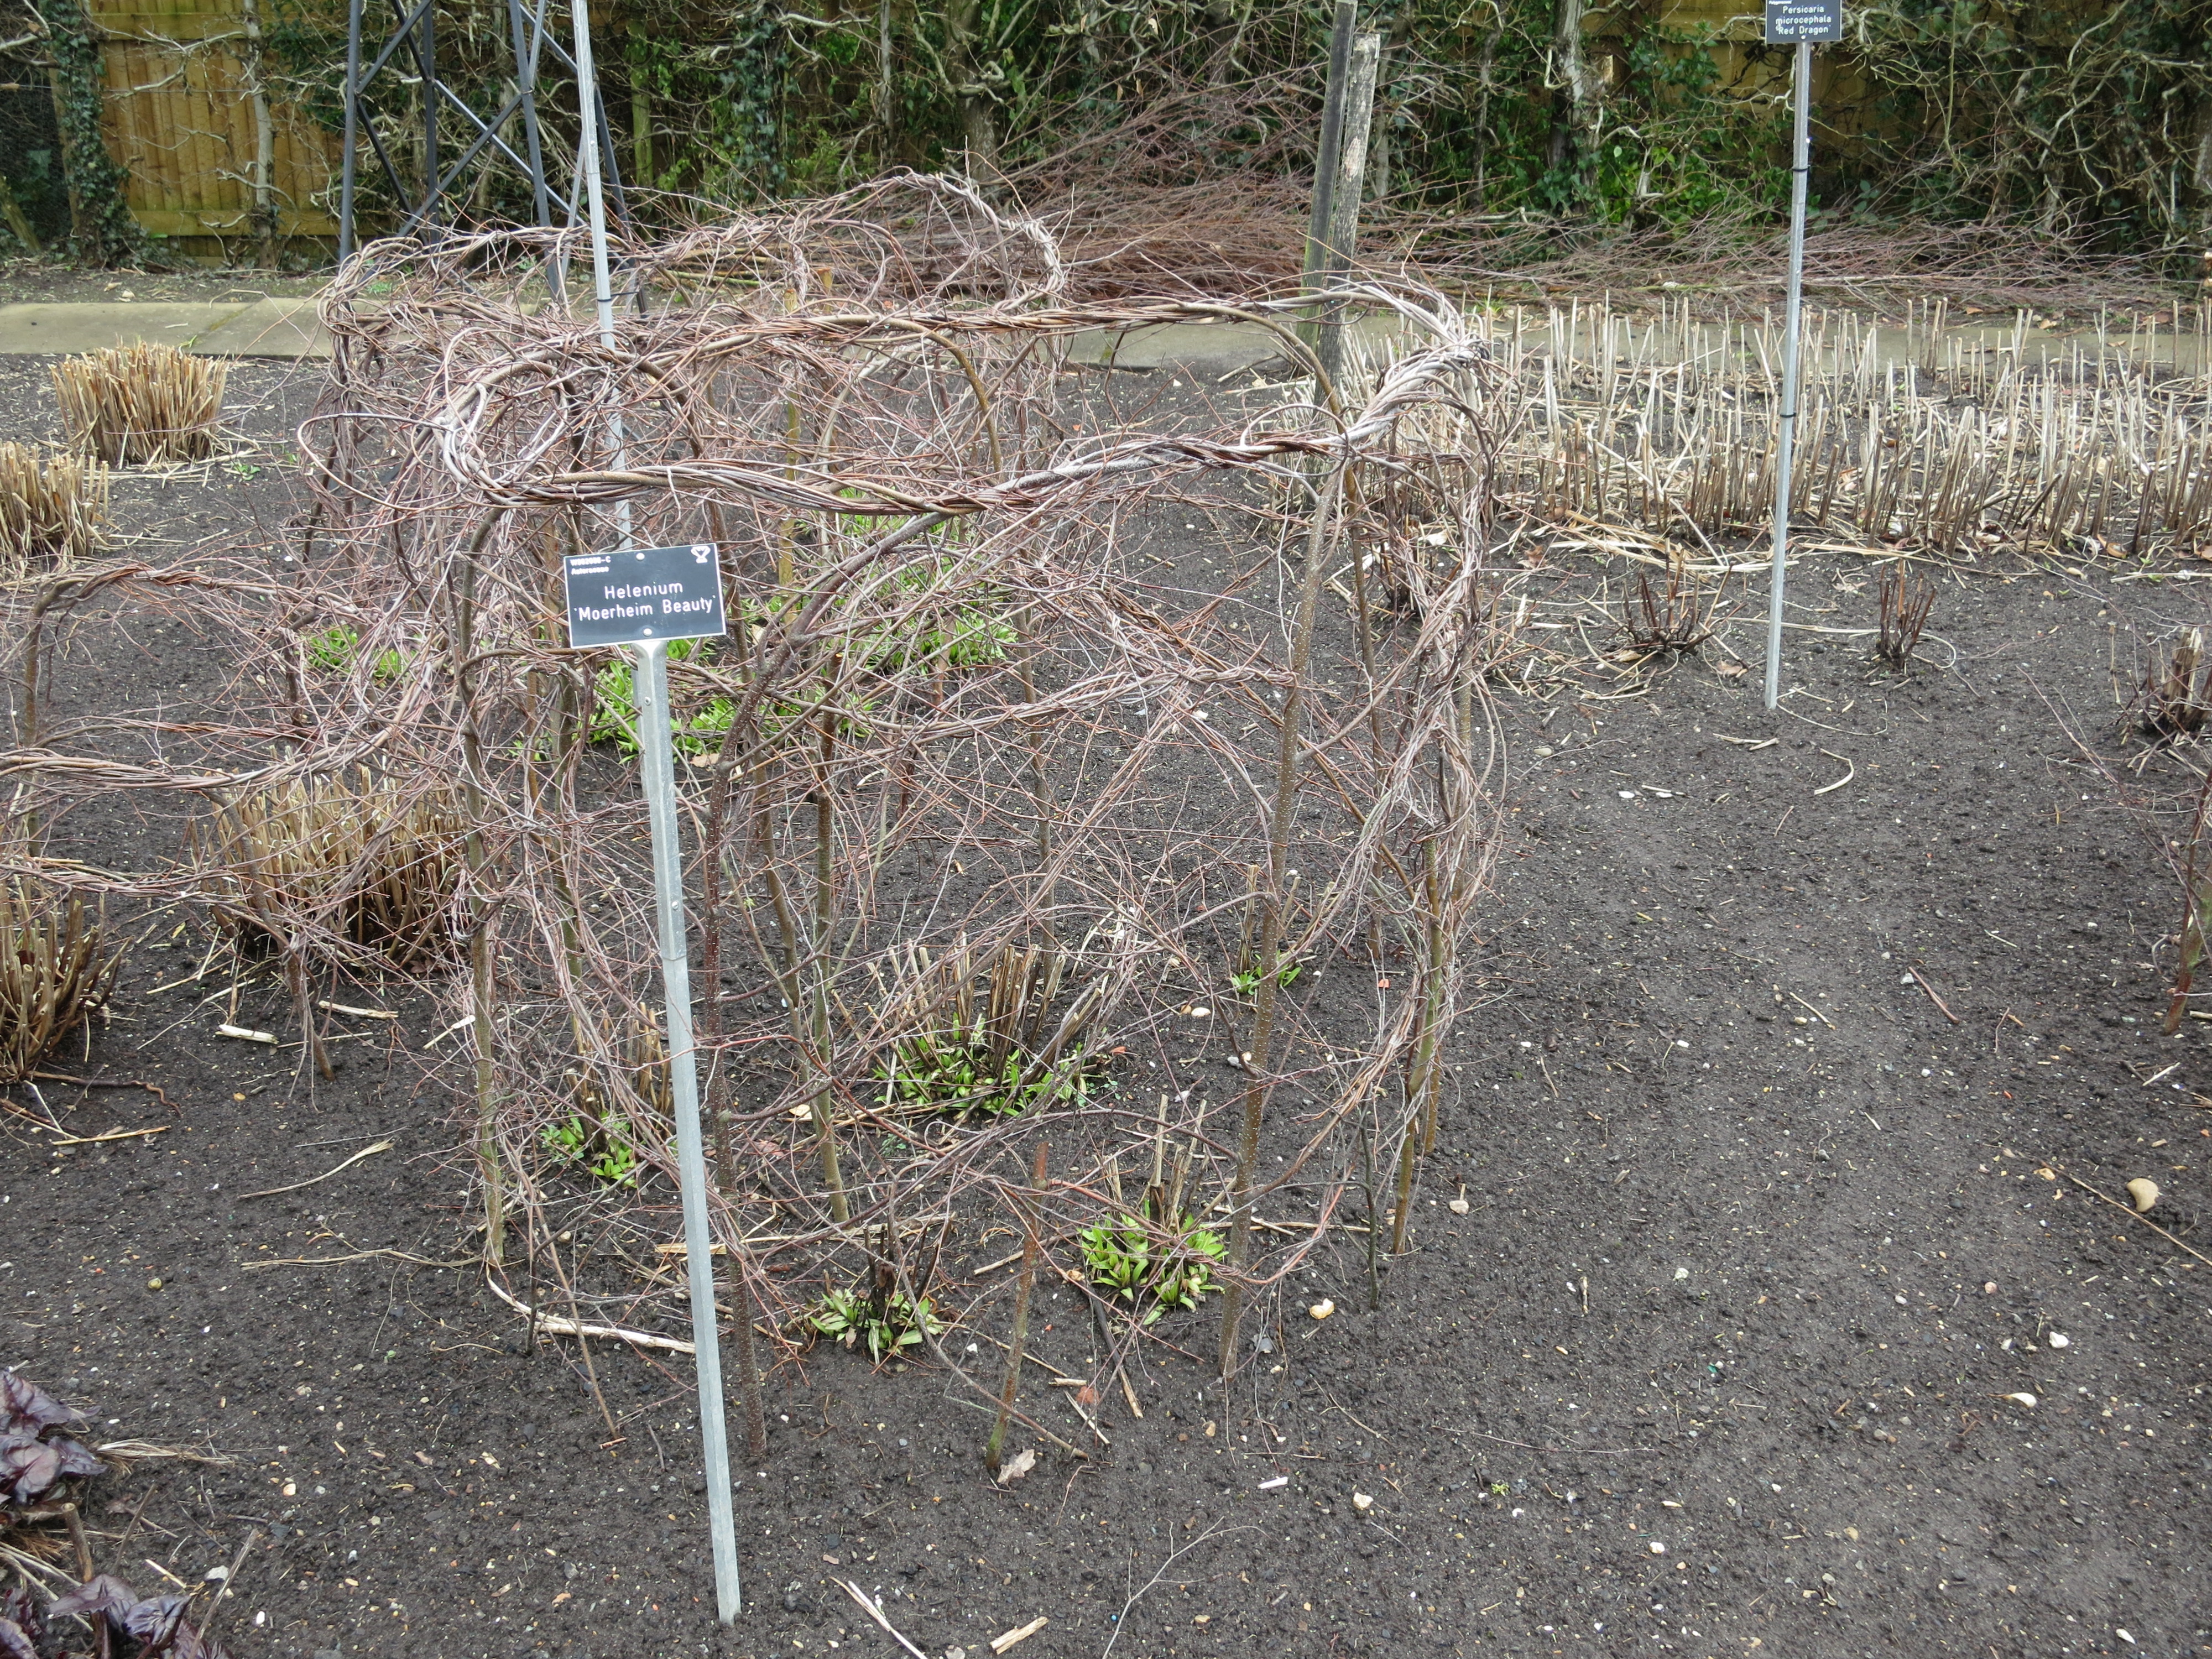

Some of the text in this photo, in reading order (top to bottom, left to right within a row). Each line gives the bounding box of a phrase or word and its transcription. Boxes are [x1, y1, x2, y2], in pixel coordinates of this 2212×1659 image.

[1782, 5, 1824, 14] Persicaria
[1775, 15, 1832, 25] microcephala
[604, 581, 683, 599] Helenium
